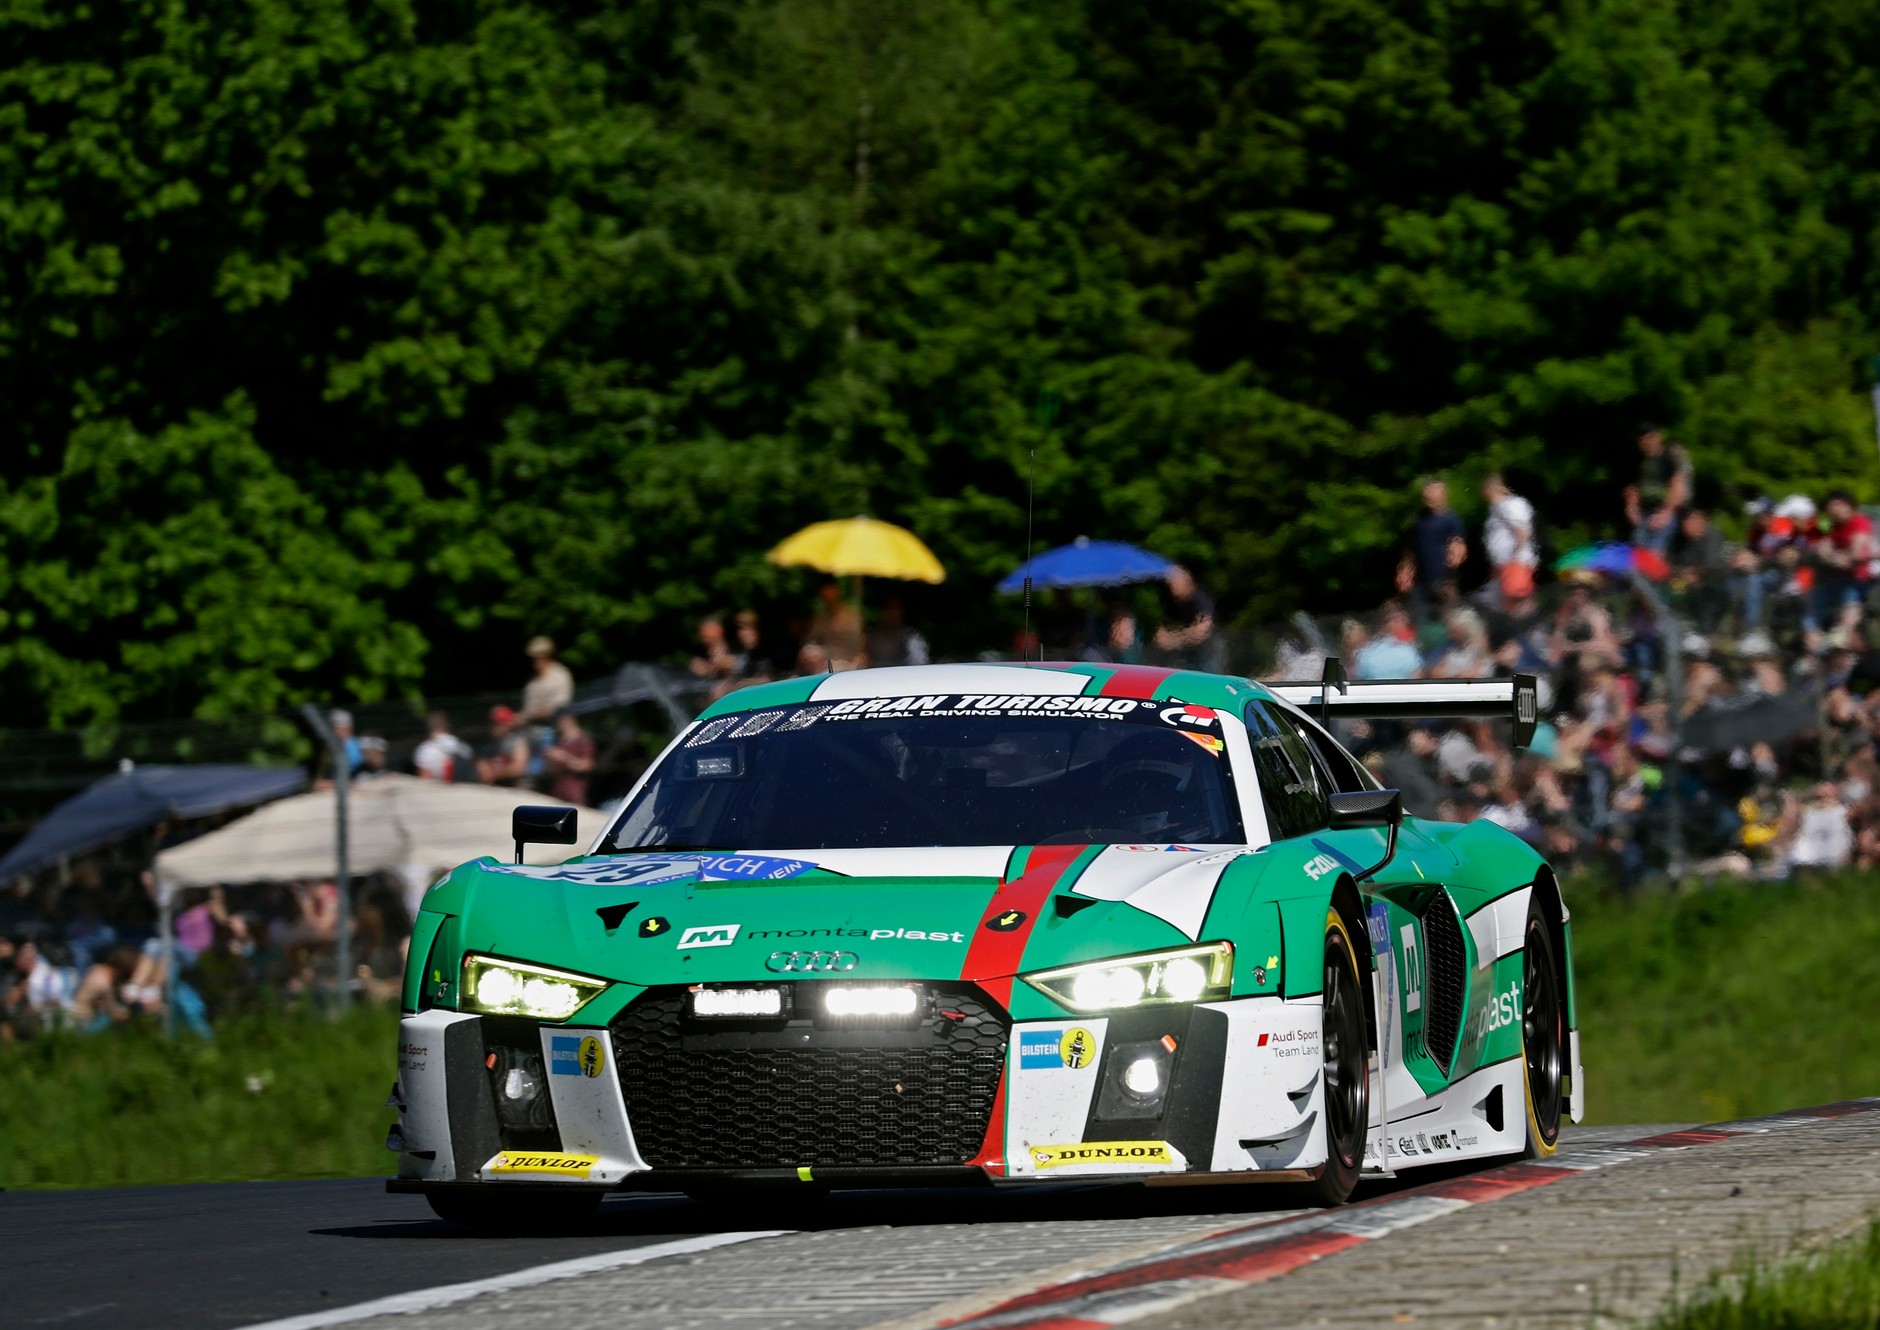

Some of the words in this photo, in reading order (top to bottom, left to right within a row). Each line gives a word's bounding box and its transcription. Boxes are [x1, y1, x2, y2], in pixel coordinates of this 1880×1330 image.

[829, 695, 949, 714] GRAN
[953, 695, 1138, 714] TURISMO
[824, 713, 860, 721] THE
[865, 710, 914, 719] REAL
[1007, 709, 1124, 720] SIMULATOR
[544, 862, 671, 883] 29
[646, 872, 696, 886] ADAC
[748, 927, 965, 943] montaplast
[1272, 1030, 1296, 1042] Audi
[1297, 1029, 1319, 1042] Sport
[1021, 1044, 1059, 1056] BILSTEIN
[1272, 1046, 1301, 1058] Team
[1302, 1045, 1319, 1056] Land
[1059, 1147, 1164, 1160] DUNLOP
[509, 1157, 592, 1169] DUNLOP
